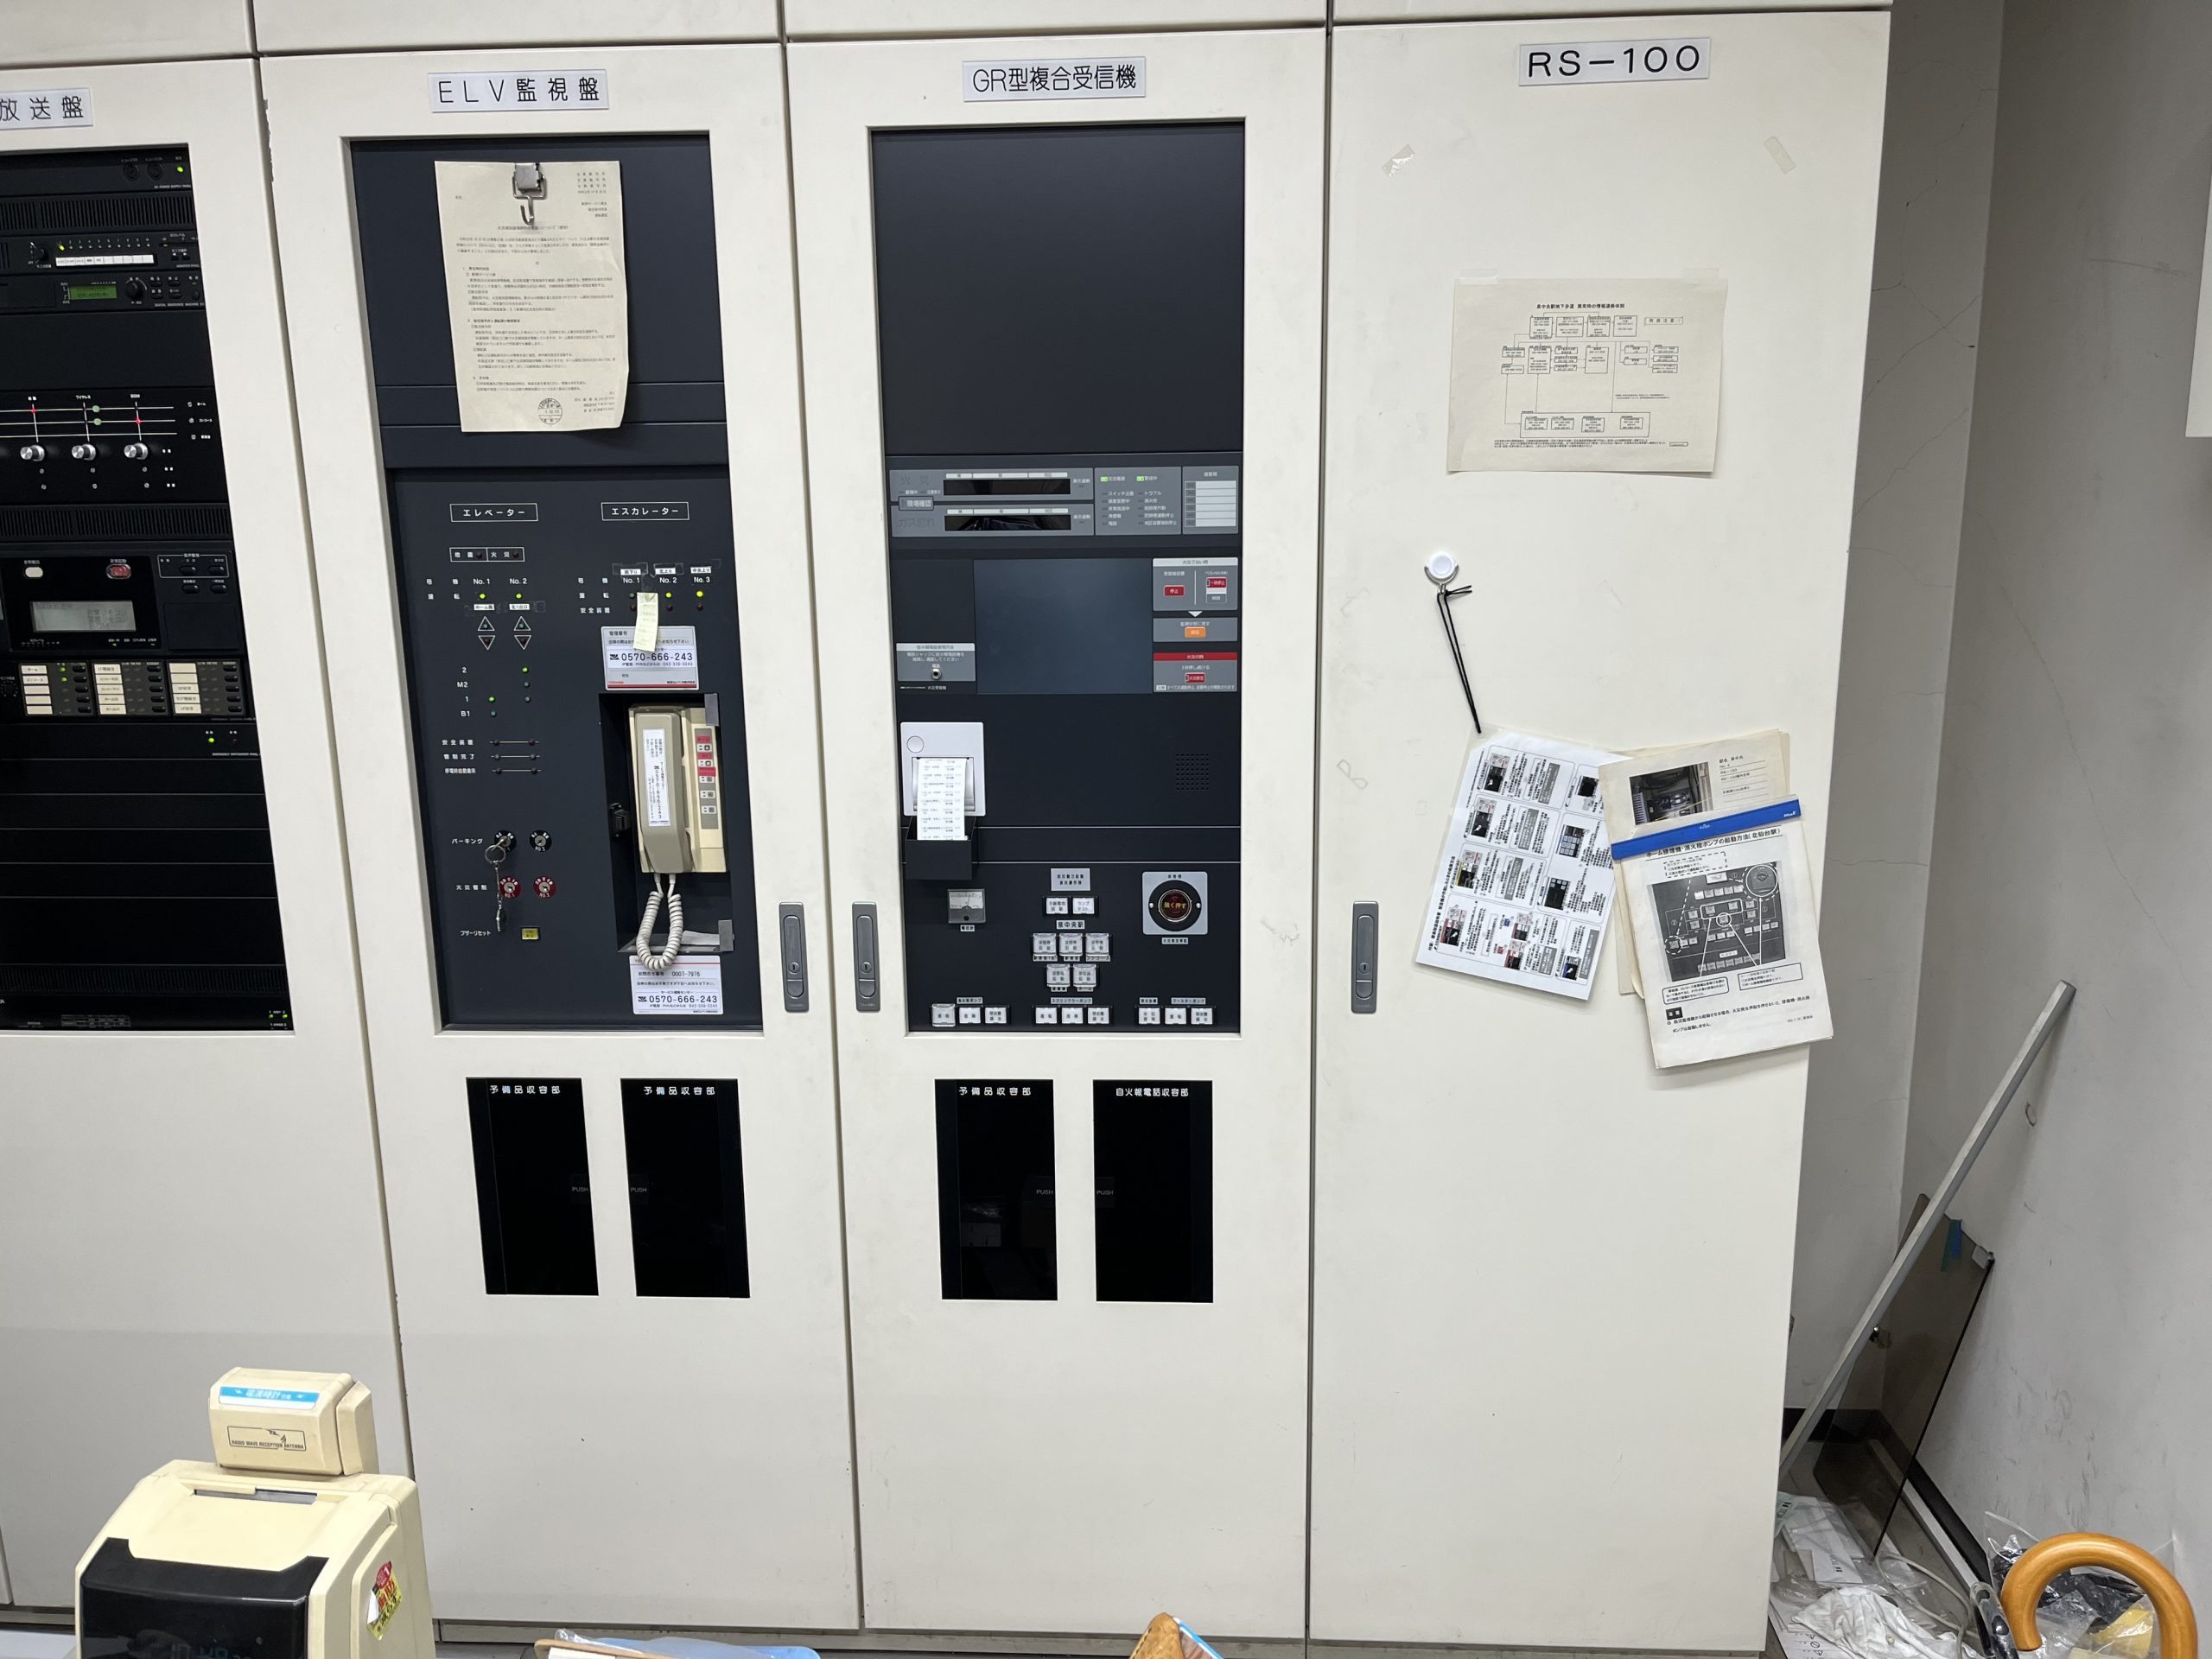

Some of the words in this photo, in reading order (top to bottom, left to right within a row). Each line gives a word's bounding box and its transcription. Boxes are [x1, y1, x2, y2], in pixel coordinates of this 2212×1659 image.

[1529, 45, 1700, 78] RS-100
[973, 64, 1136, 92] GR型複合受信機
[438, 77, 600, 103] ELV監視盤
[0, 95, 84, 122] 放送盤
[463, 508, 525, 517] エレベーター
[611, 507, 679, 516] エスカレーター
[621, 652, 693, 661] 0570-666-243
[489, 1084, 561, 1095] 予備品収容部
[643, 1086, 715, 1096] 予備品収容部
[958, 1086, 1032, 1096] 予備品収容部
[1116, 1087, 1189, 1097] 自火報電話収容部
